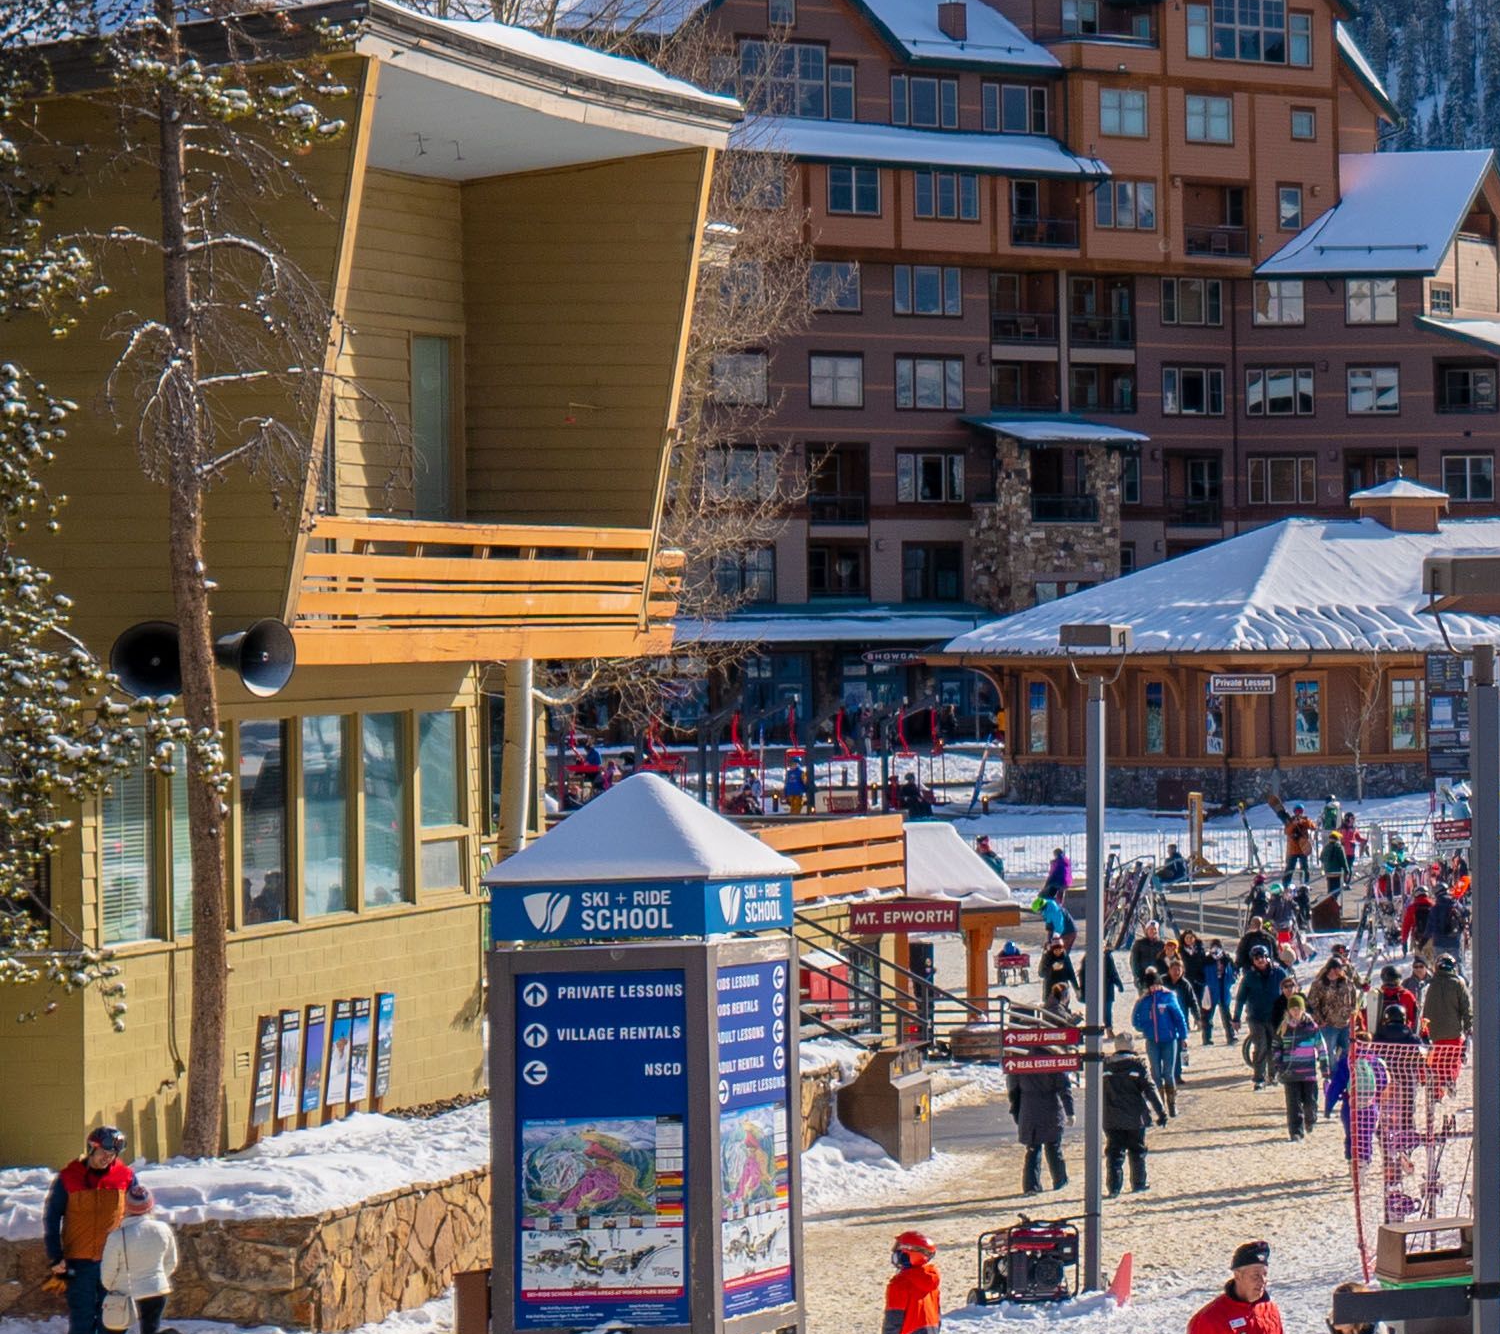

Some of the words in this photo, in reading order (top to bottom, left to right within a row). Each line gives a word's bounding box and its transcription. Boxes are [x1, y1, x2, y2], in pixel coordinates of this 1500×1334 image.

[1215, 678, 1242, 687] Private
[1244, 678, 1271, 687] Lesson
[581, 892, 609, 907] SKI
[633, 890, 672, 905] RIDE
[744, 884, 756, 898] SKI
[765, 883, 781, 898] RIDE
[581, 907, 673, 931] SCHOOL
[745, 899, 783, 923] SCHOOL
[854, 913, 879, 926] MT.
[884, 909, 954, 925] EPWORTH
[731, 974, 760, 989] LESSONS
[558, 985, 615, 999] PRIVATE
[620, 983, 683, 998] LESSONS
[732, 999, 759, 1014] RENTALS
[557, 1027, 615, 1041] VILLAGE
[620, 1025, 681, 1040] RENTALS
[737, 1025, 765, 1042] LESSONS
[1017, 1032, 1038, 1042] SHOPS
[1043, 1031, 1066, 1042] DINING
[644, 1063, 682, 1077] NSCD
[738, 1055, 764, 1072] RENTALS
[1017, 1059, 1033, 1069] REAL
[1034, 1058, 1056, 1068] ESTATE
[1057, 1057, 1078, 1067] SALES
[732, 1079, 757, 1096] PRIVATE
[757, 1075, 786, 1093] LESSONS
